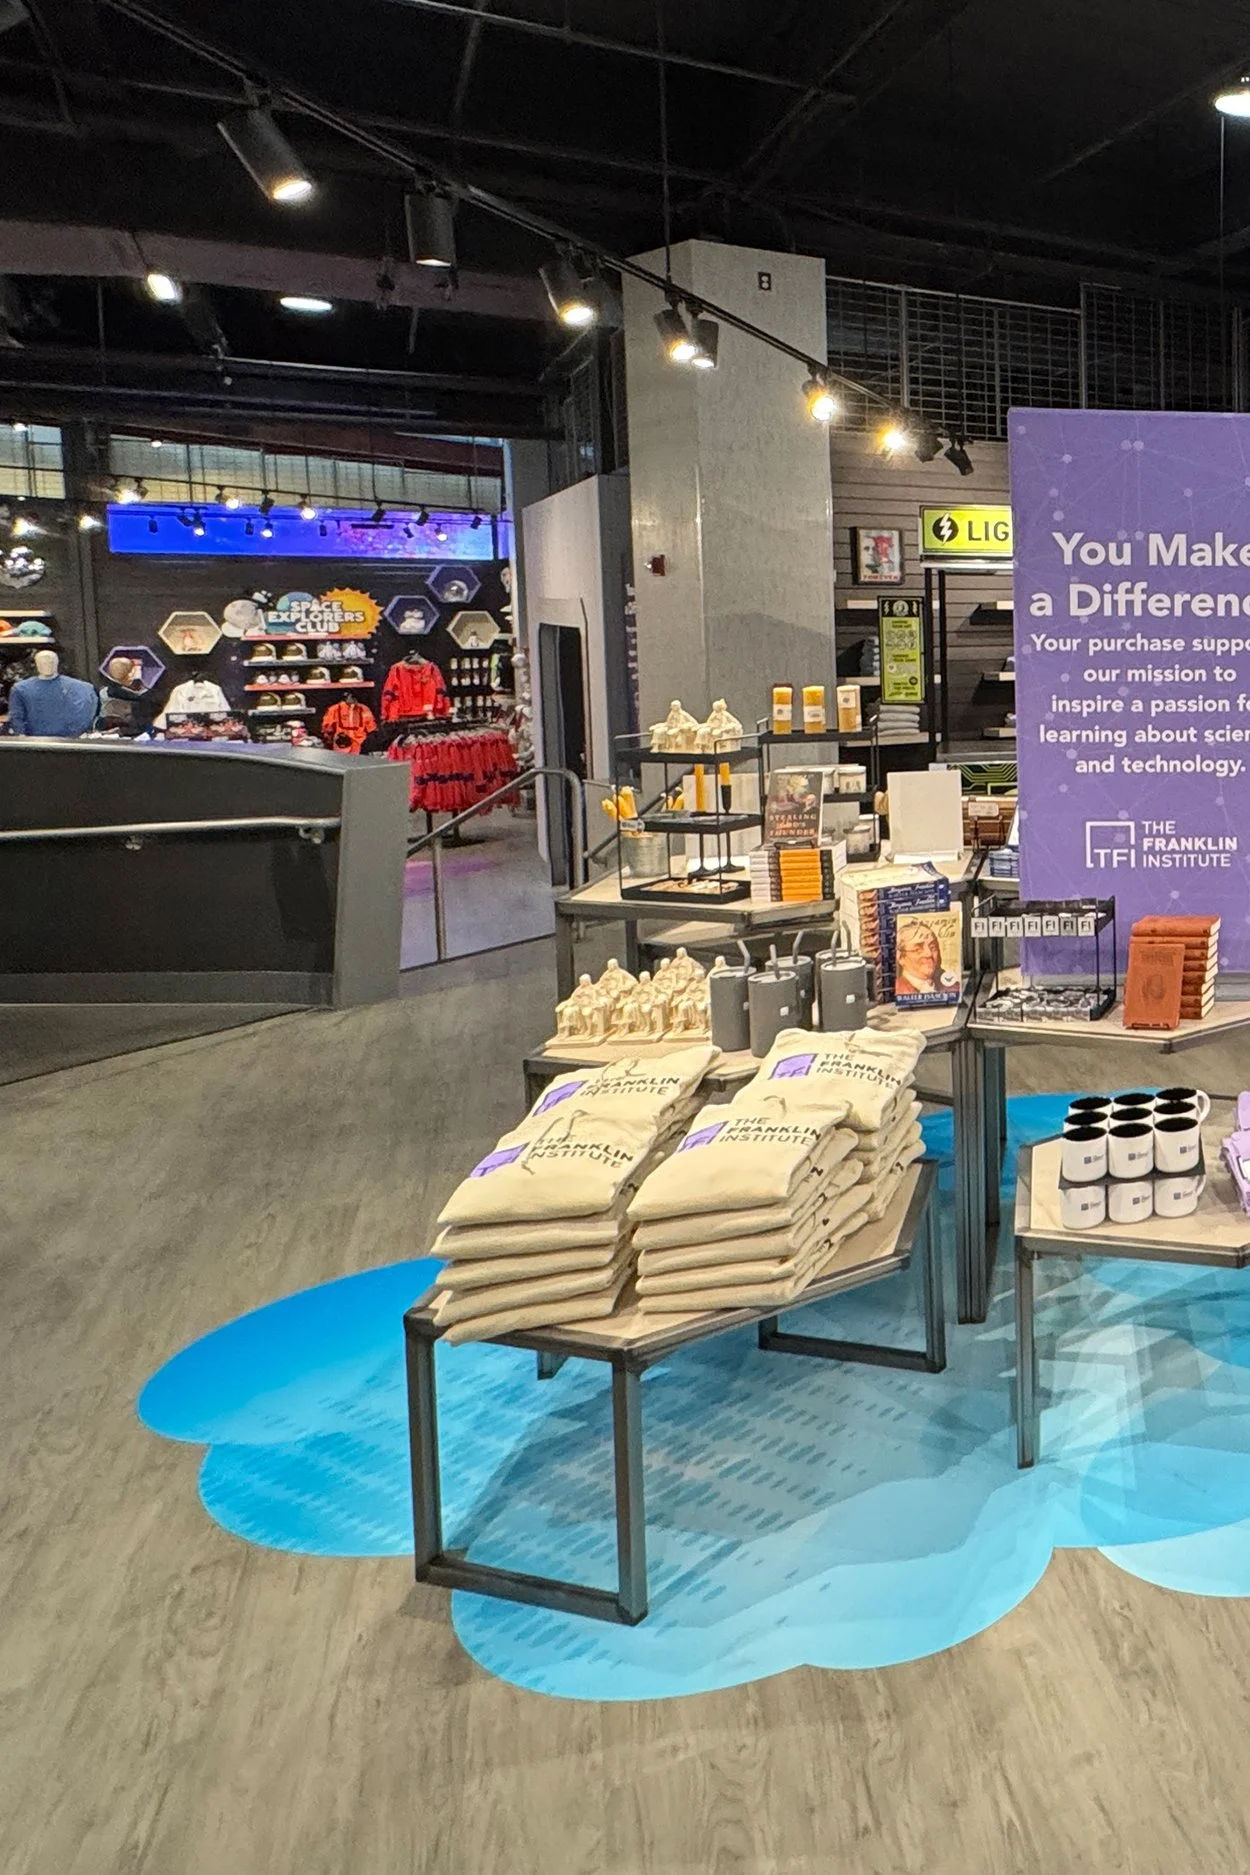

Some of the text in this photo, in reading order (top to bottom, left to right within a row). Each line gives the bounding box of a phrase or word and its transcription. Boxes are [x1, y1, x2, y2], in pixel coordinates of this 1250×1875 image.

[1052, 532, 1131, 566] You
[290, 599, 342, 611] SPACE
[1030, 591, 1053, 617] a
[268, 610, 365, 623] EXPLORERS
[295, 621, 340, 632] CLUB
[1030, 634, 1082, 651] Your
[1088, 634, 1186, 656] purchase
[1083, 664, 1237, 683] our mission to
[1052, 694, 1124, 716] inspire
[1131, 699, 1143, 713] a
[1151, 694, 1231, 717] passion
[1040, 725, 1127, 747] learning
[1134, 725, 1198, 743] about
[1075, 755, 1246, 777] and technology.
[1142, 821, 1176, 834] THE
[1143, 837, 1238, 851] FRANKLIN
[1143, 854, 1232, 868] INSTITUTE
[824, 1053, 855, 1061] THE
[816, 1068, 893, 1089] INSTITUTE
[820, 1061, 901, 1086] FRANKLIN
[735, 1117, 771, 1126] THE
[719, 1134, 814, 1147] INSTITUTE
[726, 1125, 821, 1140] FRANKLIN
[532, 1143, 634, 1162] FRANKLIN
